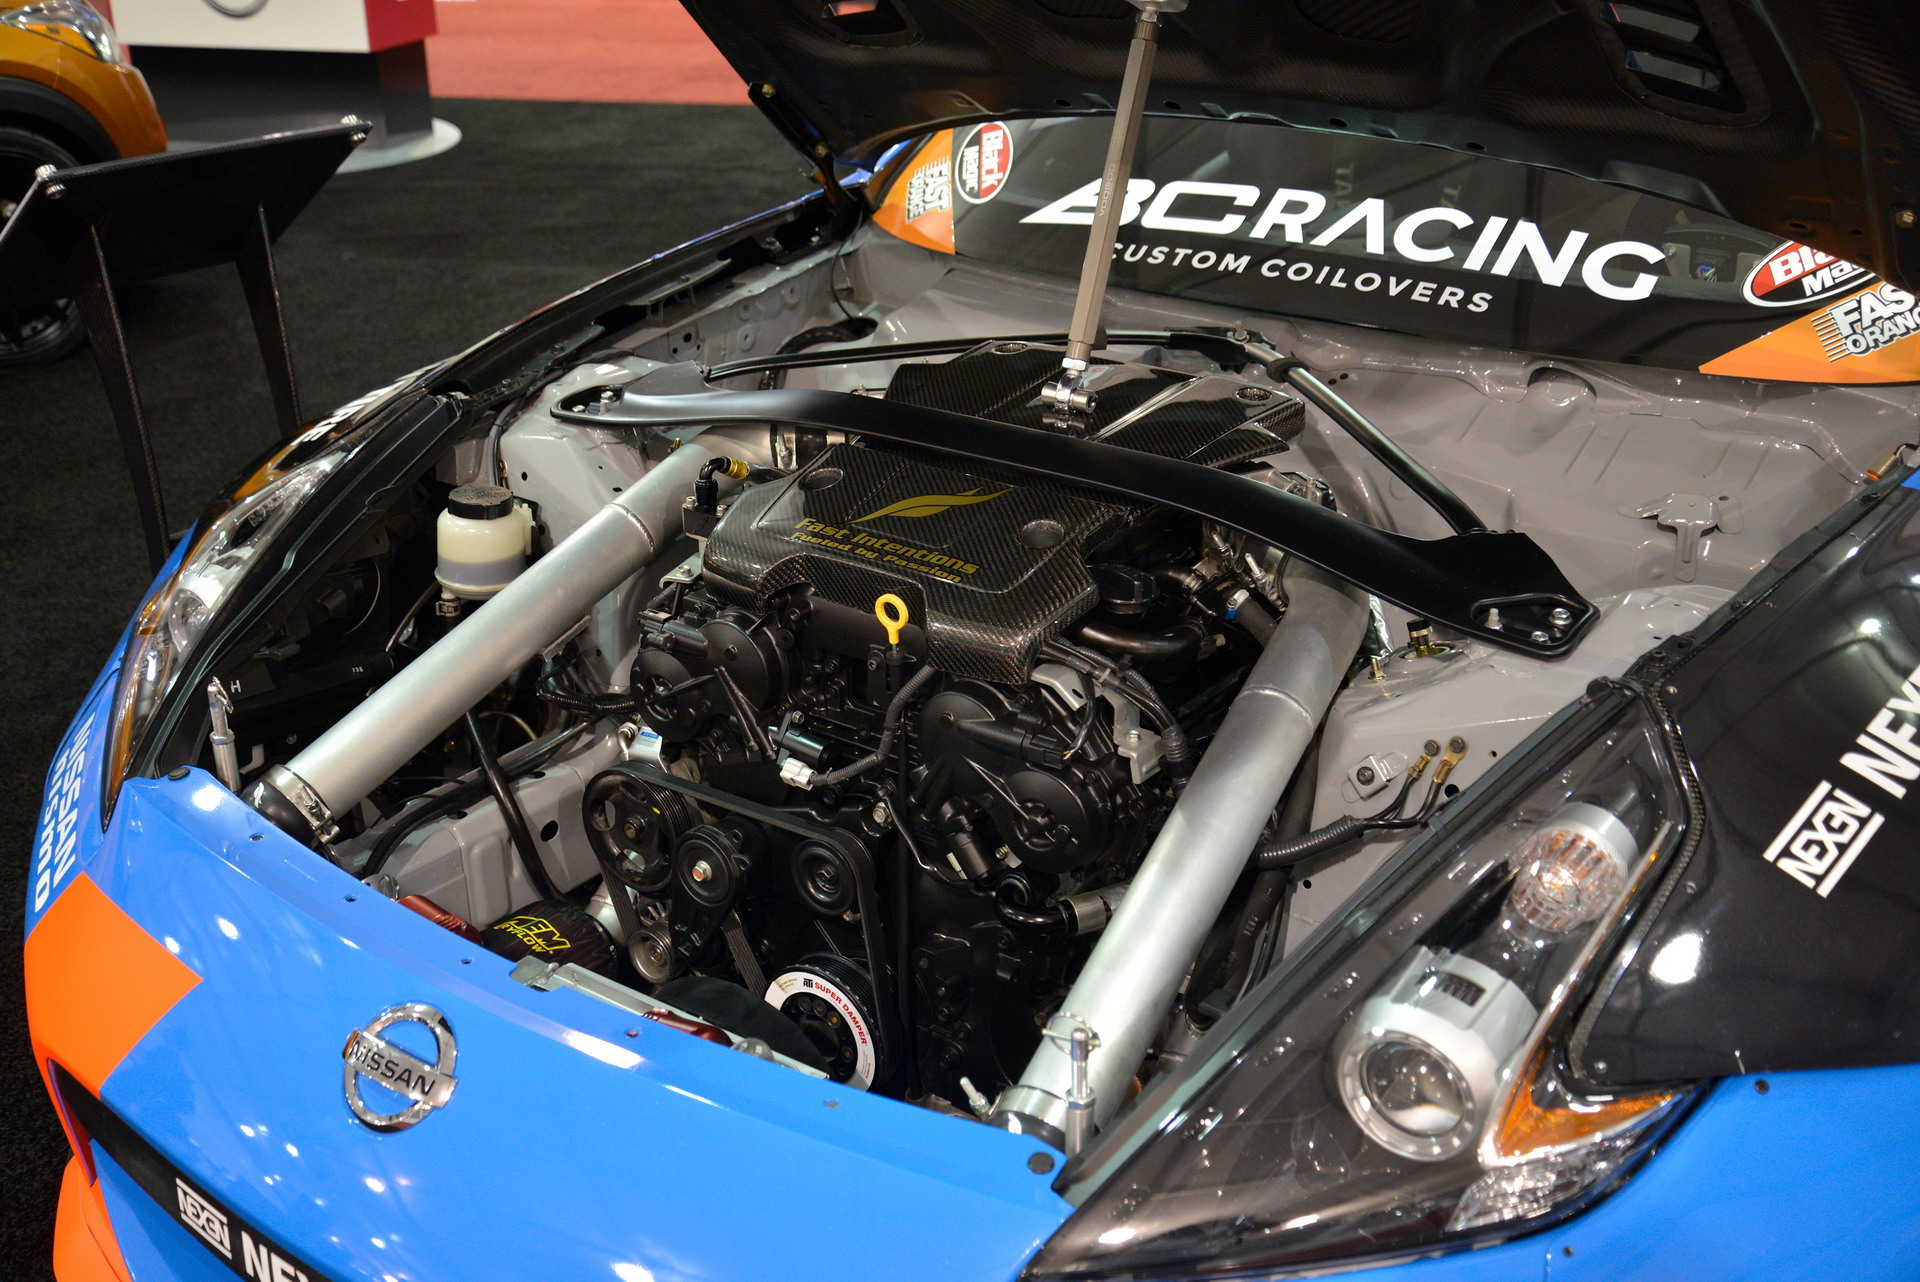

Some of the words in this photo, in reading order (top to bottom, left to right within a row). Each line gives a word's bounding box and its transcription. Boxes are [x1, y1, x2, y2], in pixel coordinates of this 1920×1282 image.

[924, 161, 951, 211] FAST
[962, 145, 979, 194] Magic
[981, 129, 1004, 190] Black
[907, 174, 925, 220] ORANGE
[1260, 258, 1494, 313] COILOVERS
[789, 531, 851, 551] Fueled
[853, 547, 880, 560] by
[883, 553, 963, 583] Passion
[793, 516, 850, 540] Fast
[851, 532, 981, 575] Intentions
[53, 711, 96, 888] NISSAN
[1774, 786, 1873, 890] NEXEN
[814, 981, 842, 1005] SUPER
[842, 1003, 868, 1045] DAMPER
[349, 1039, 436, 1097] NISSAN
[176, 1185, 232, 1252] NEXEN
